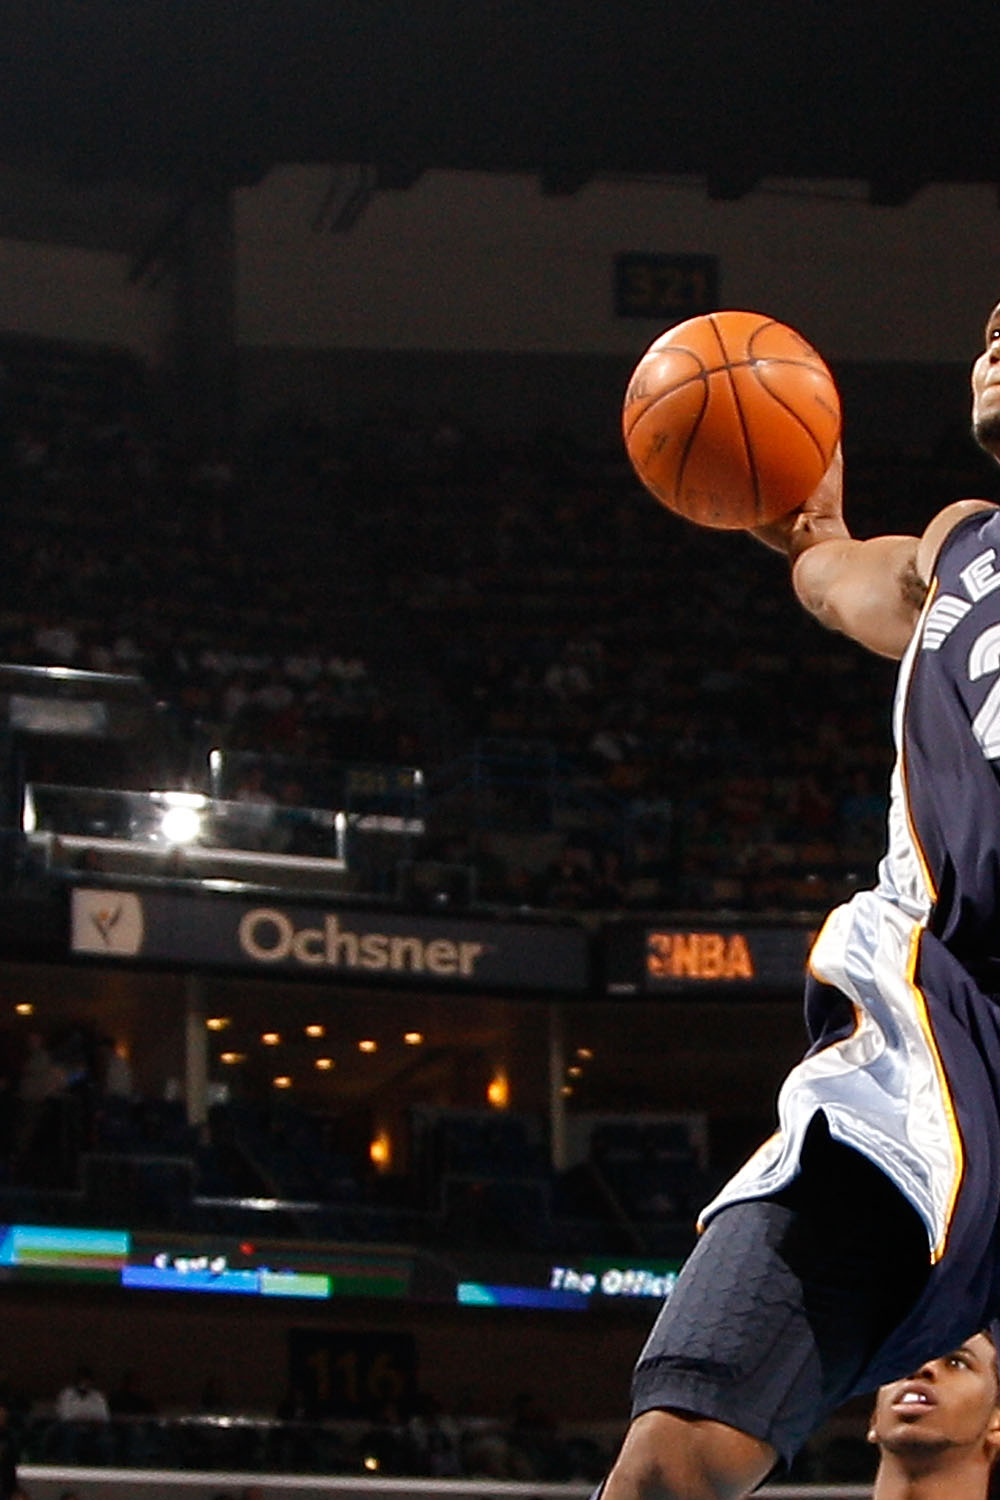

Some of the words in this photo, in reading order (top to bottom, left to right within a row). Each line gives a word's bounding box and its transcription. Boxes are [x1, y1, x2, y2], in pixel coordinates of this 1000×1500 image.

[239, 907, 483, 977] Ochsner
[672, 933, 754, 978] NBA
[551, 1267, 596, 1294] The
[305, 1348, 405, 1404] 116
